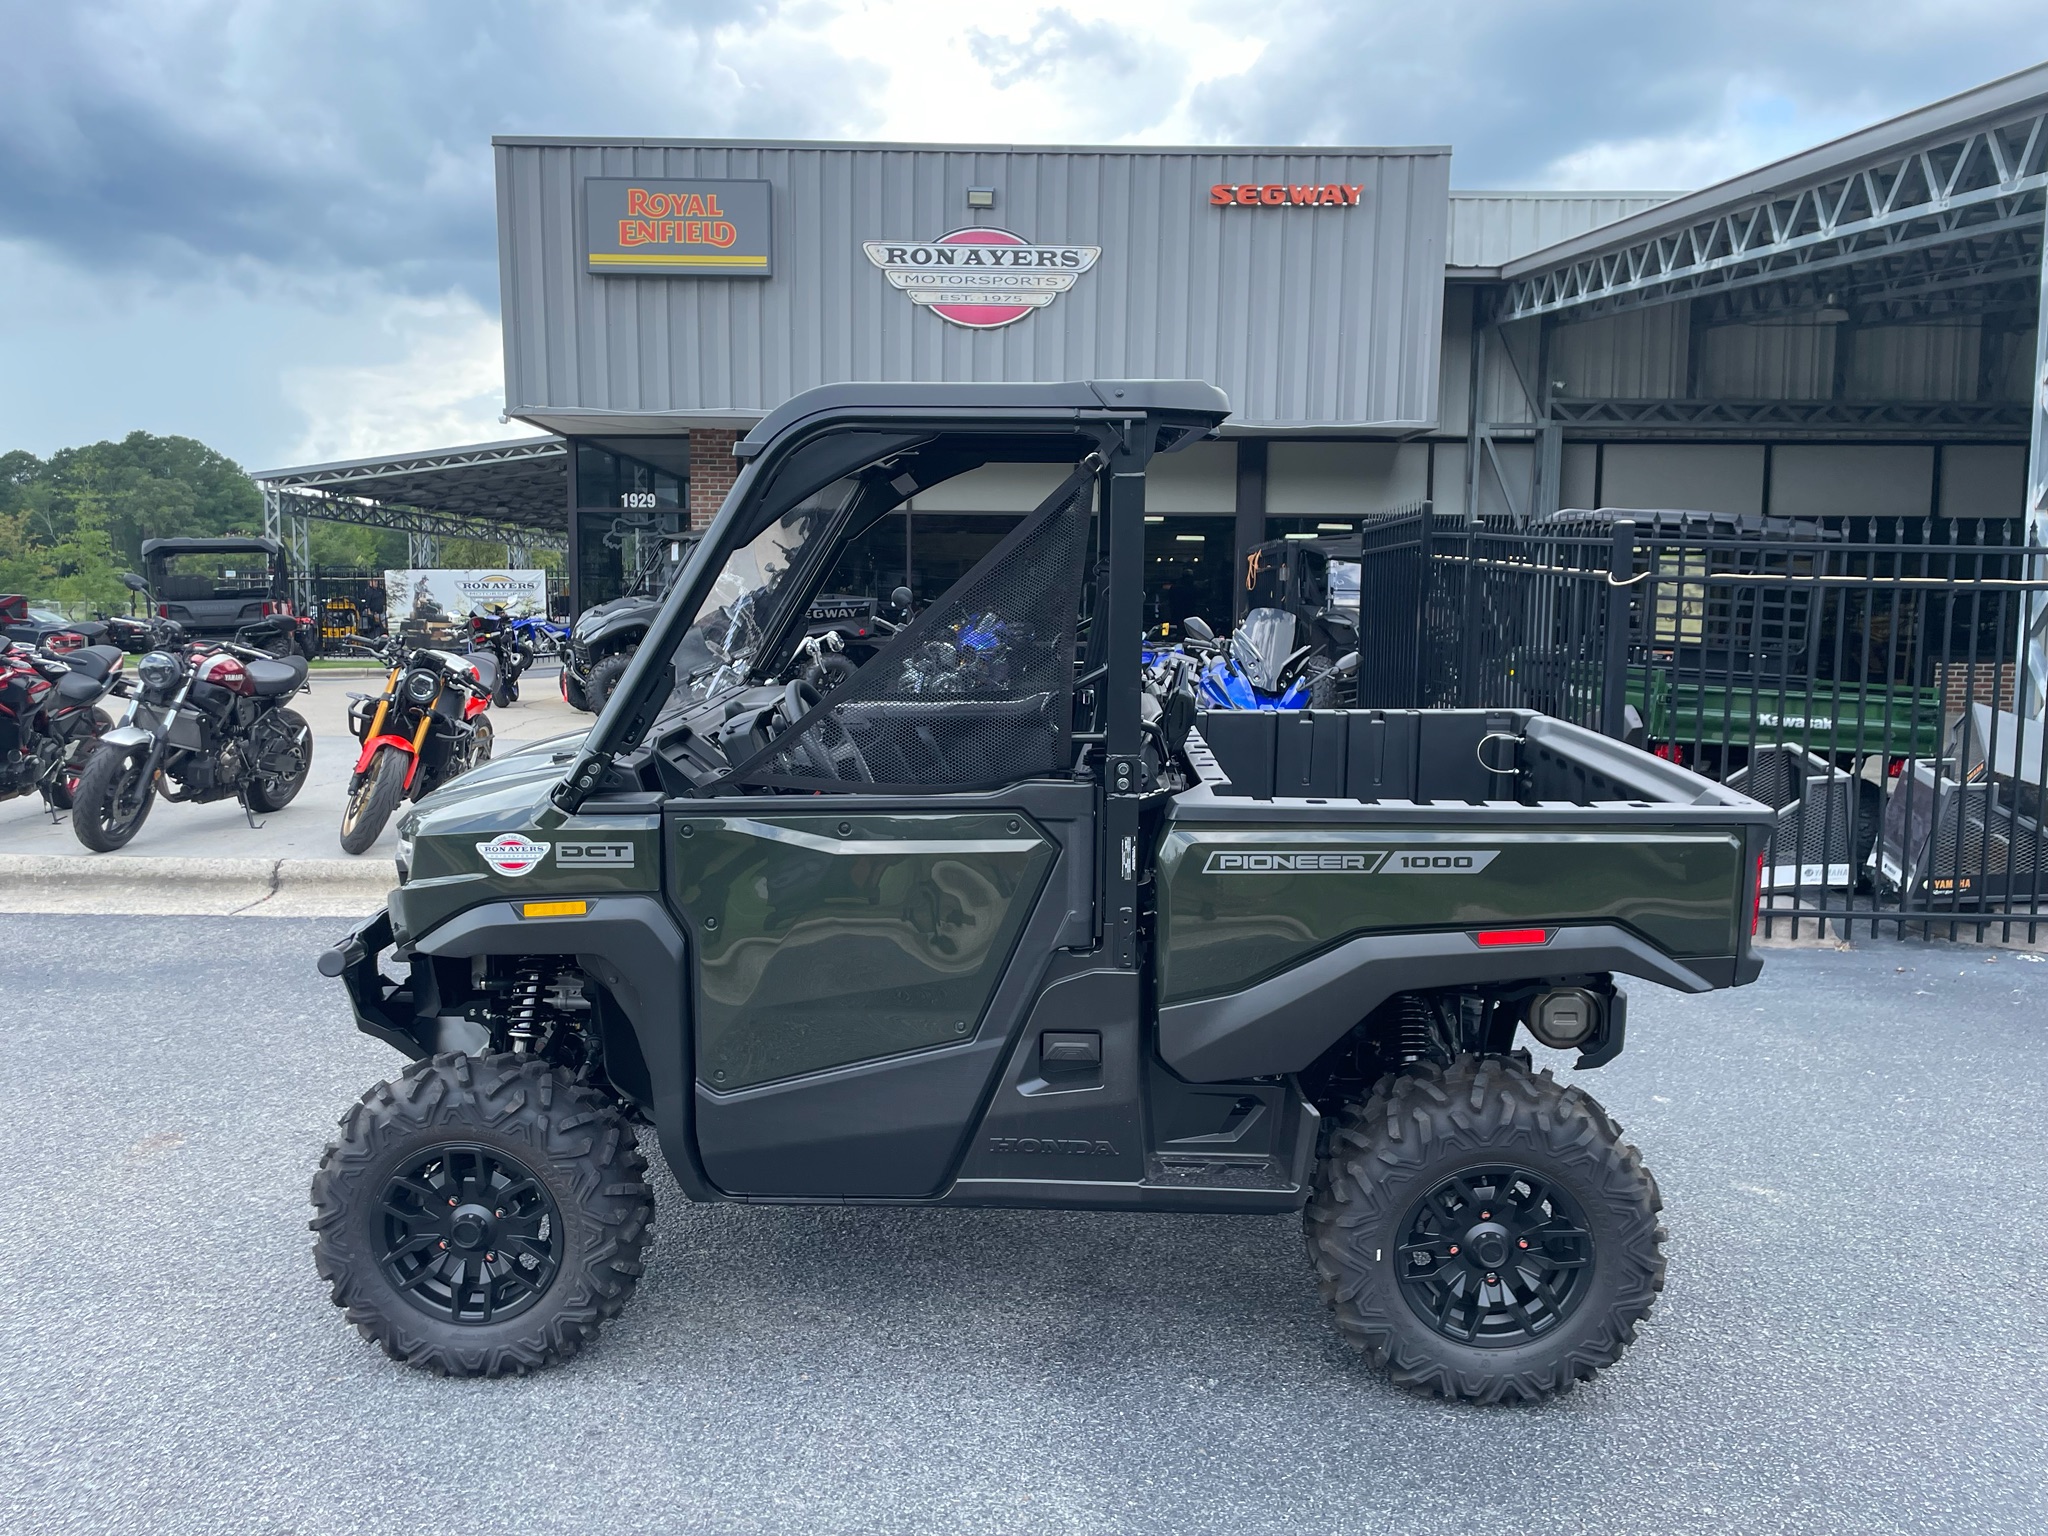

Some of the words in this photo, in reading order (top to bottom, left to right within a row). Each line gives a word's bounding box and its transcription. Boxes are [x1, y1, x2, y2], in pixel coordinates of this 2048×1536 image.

[1210, 184, 1364, 205] SEGWAY
[627, 188, 723, 219] ROYAL
[618, 219, 737, 248] ENFIELD
[885, 247, 957, 265] RON
[963, 249, 1080, 267] AYERS
[904, 275, 1058, 286] MOTORSPORTS
[940, 294, 973, 302] EST.
[621, 492, 656, 508] 1929
[561, 846, 628, 857] DCT
[1219, 855, 1365, 869] PIONEER
[1400, 856, 1473, 868] 1000
[1934, 879, 1971, 889] YAMHA
[989, 1137, 1120, 1156] HONDA
